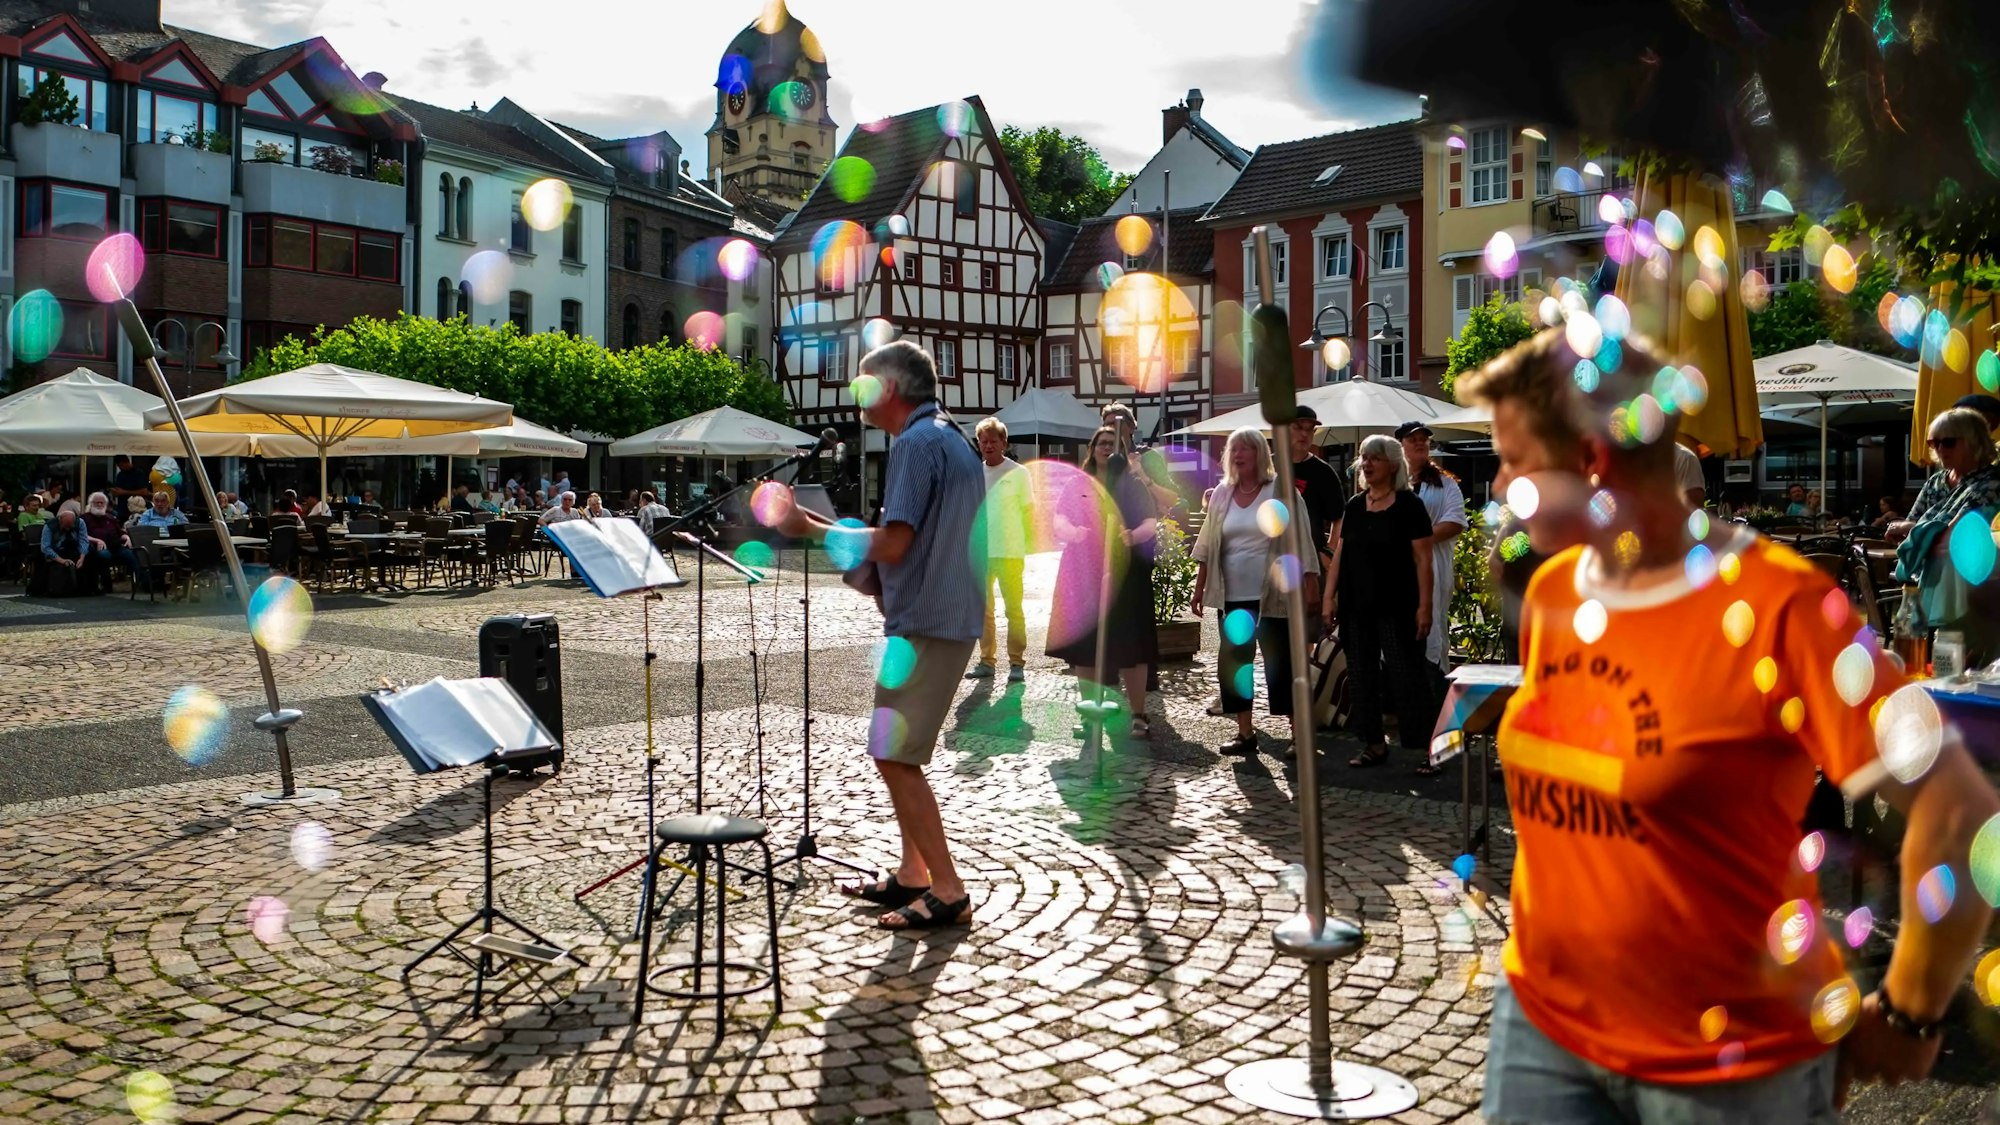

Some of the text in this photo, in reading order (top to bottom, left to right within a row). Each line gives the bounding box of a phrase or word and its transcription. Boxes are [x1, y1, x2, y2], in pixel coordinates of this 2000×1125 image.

[1756, 376, 1839, 385] nediktiner
[1590, 656, 1632, 687] ON
[1629, 688, 1663, 758] THE
